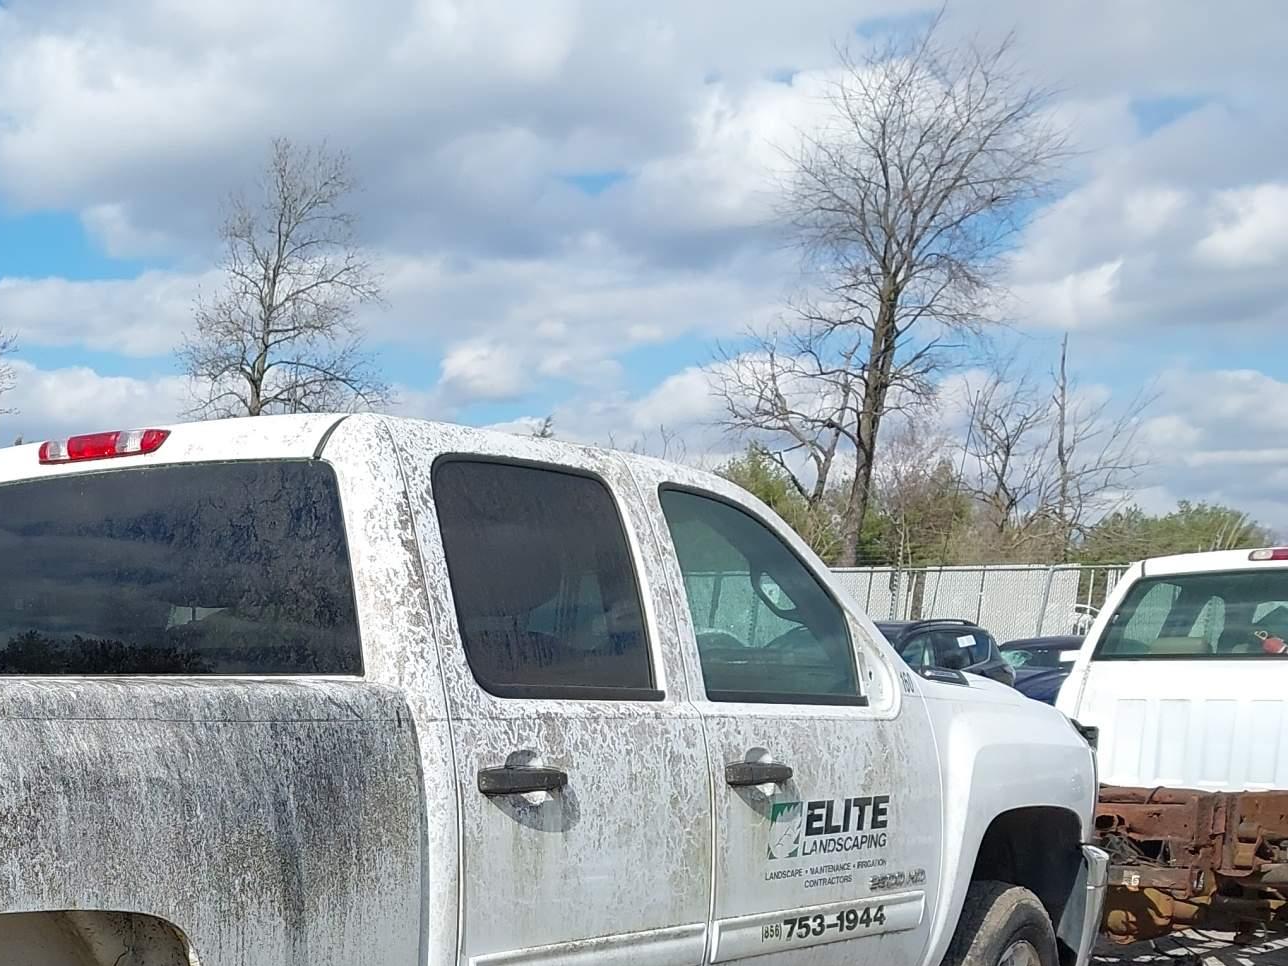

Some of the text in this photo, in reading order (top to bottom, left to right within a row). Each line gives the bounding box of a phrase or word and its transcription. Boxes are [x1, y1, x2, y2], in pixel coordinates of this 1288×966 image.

[804, 795, 890, 837] ELITE
[801, 833, 888, 856] LANDSCAPING
[765, 868, 803, 880] LANDSCAPE
[809, 863, 852, 875] MAINTENANCE
[804, 875, 853, 888] CONTRACTORS
[761, 905, 887, 942] (856) 753-1944
